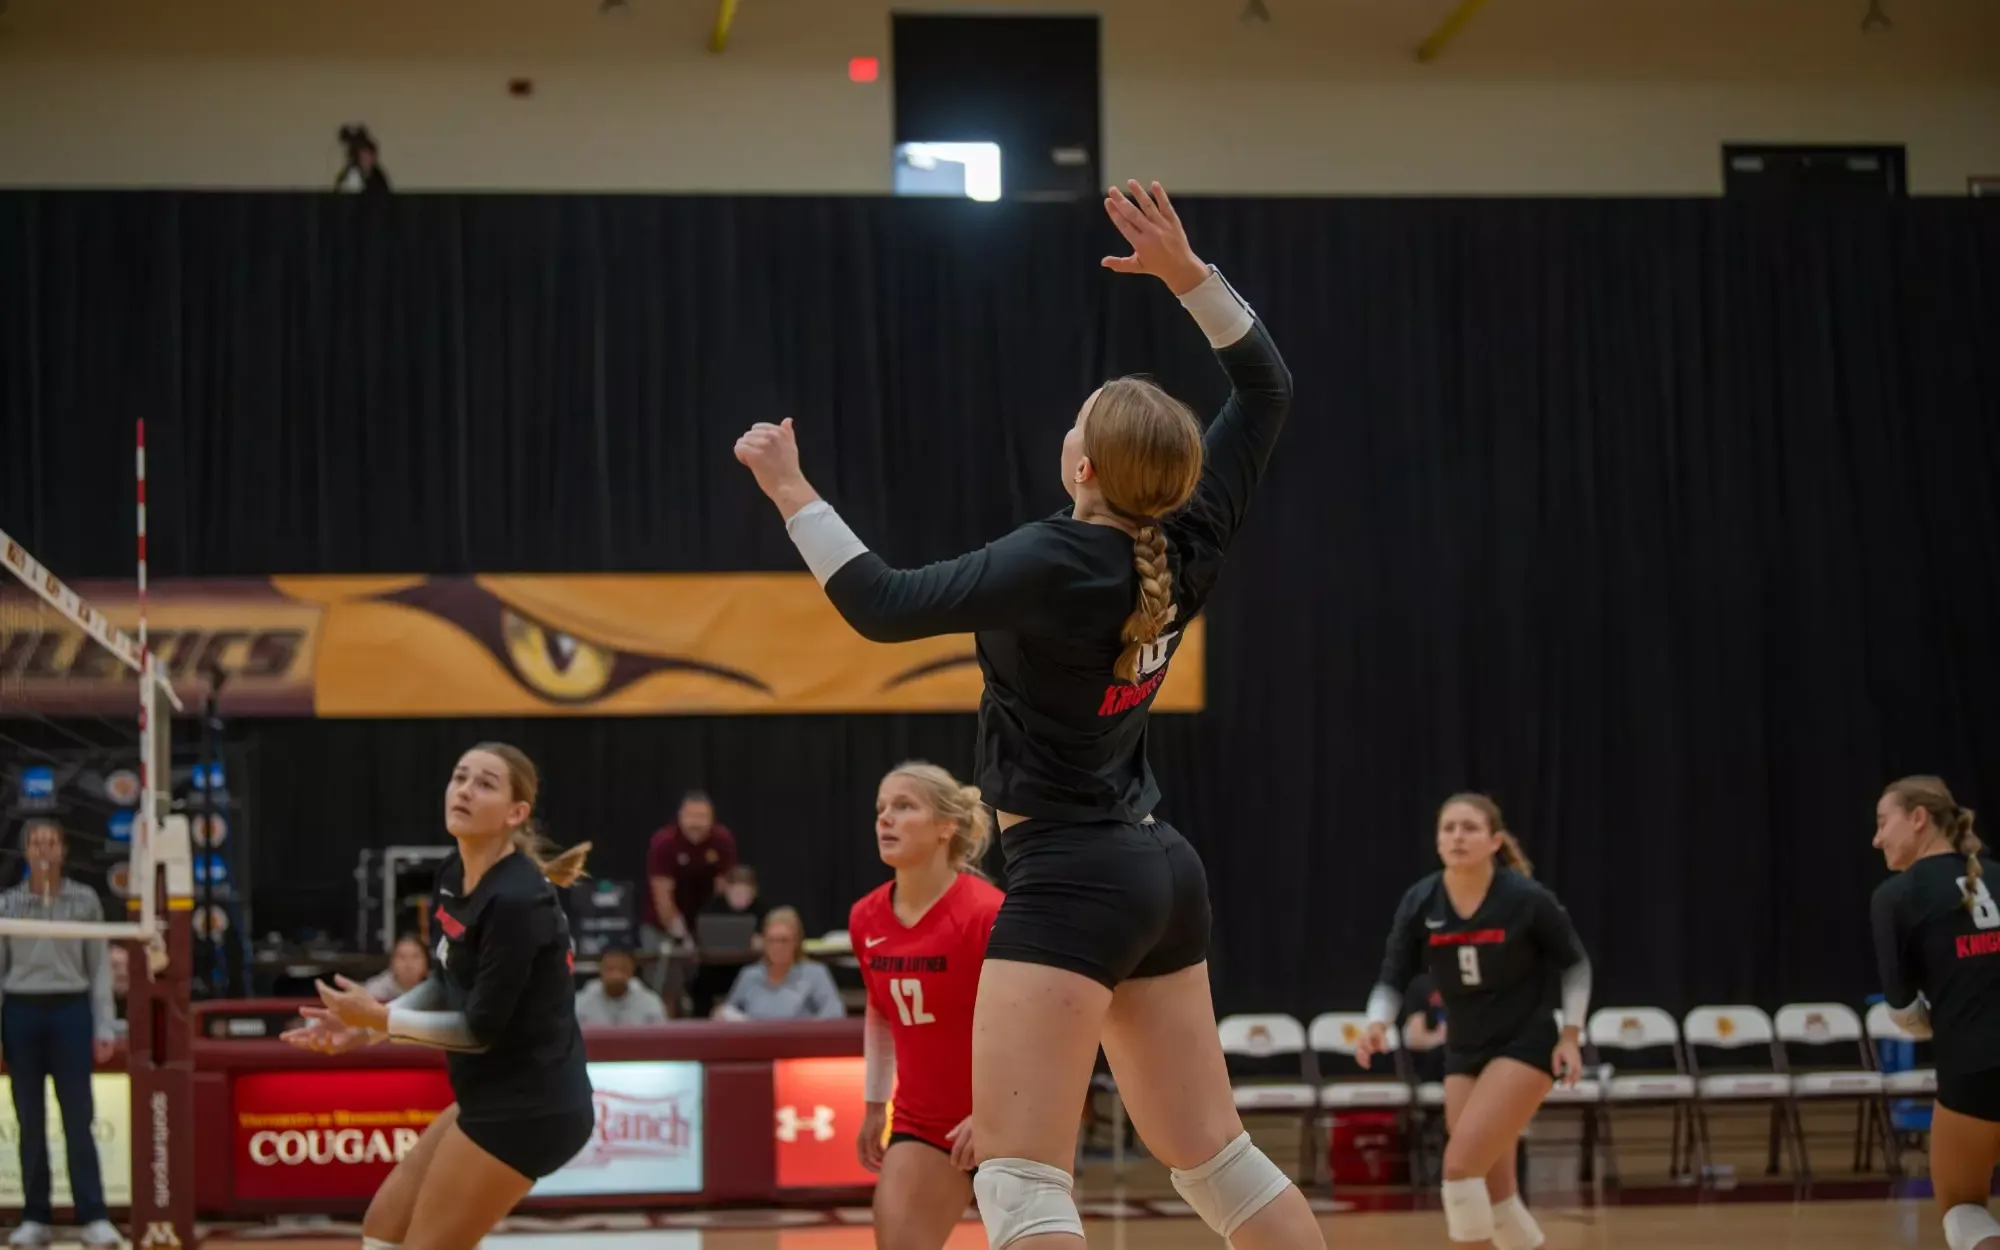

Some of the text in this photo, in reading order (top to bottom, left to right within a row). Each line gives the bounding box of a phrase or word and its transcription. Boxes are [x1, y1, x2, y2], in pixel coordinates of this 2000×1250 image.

[1955, 876, 2000, 929] 8
[1457, 945, 1481, 986] 9
[1955, 931, 2000, 959] KNIG
[889, 978, 936, 1026] 12
[249, 1127, 426, 1166] COUGAR
